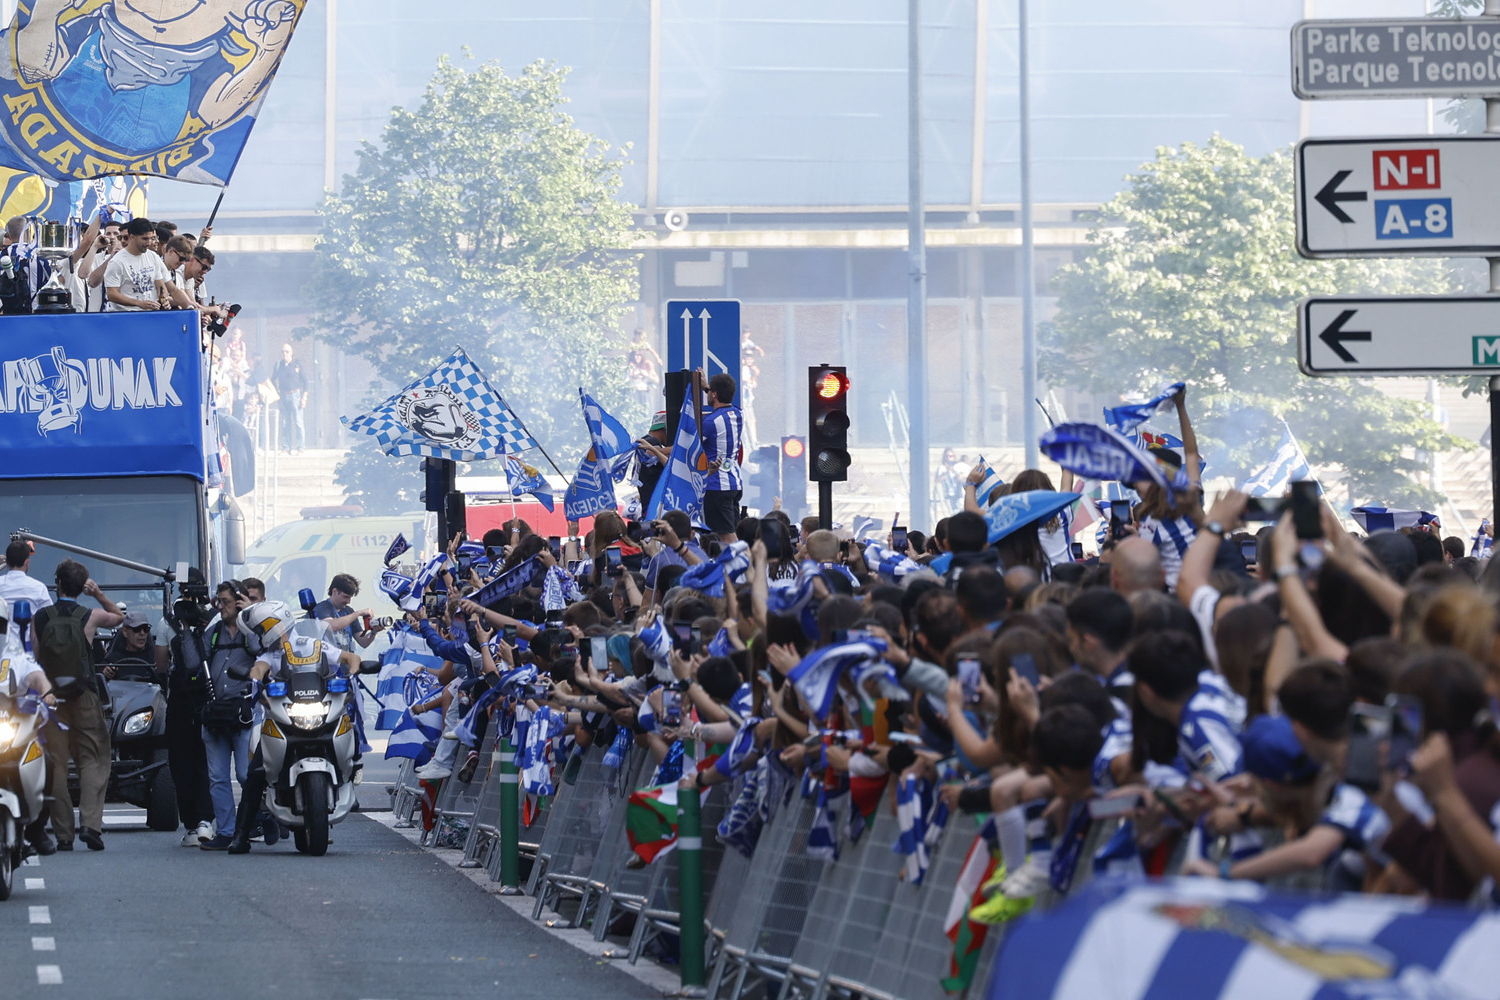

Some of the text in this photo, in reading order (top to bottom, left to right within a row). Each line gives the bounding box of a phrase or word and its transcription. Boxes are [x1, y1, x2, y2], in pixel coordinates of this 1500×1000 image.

[1307, 28, 1381, 54] Parke
[1308, 55, 1500, 88] Parque Tecnol
[1381, 203, 1448, 235] A-8
[363, 534, 388, 547] 112
